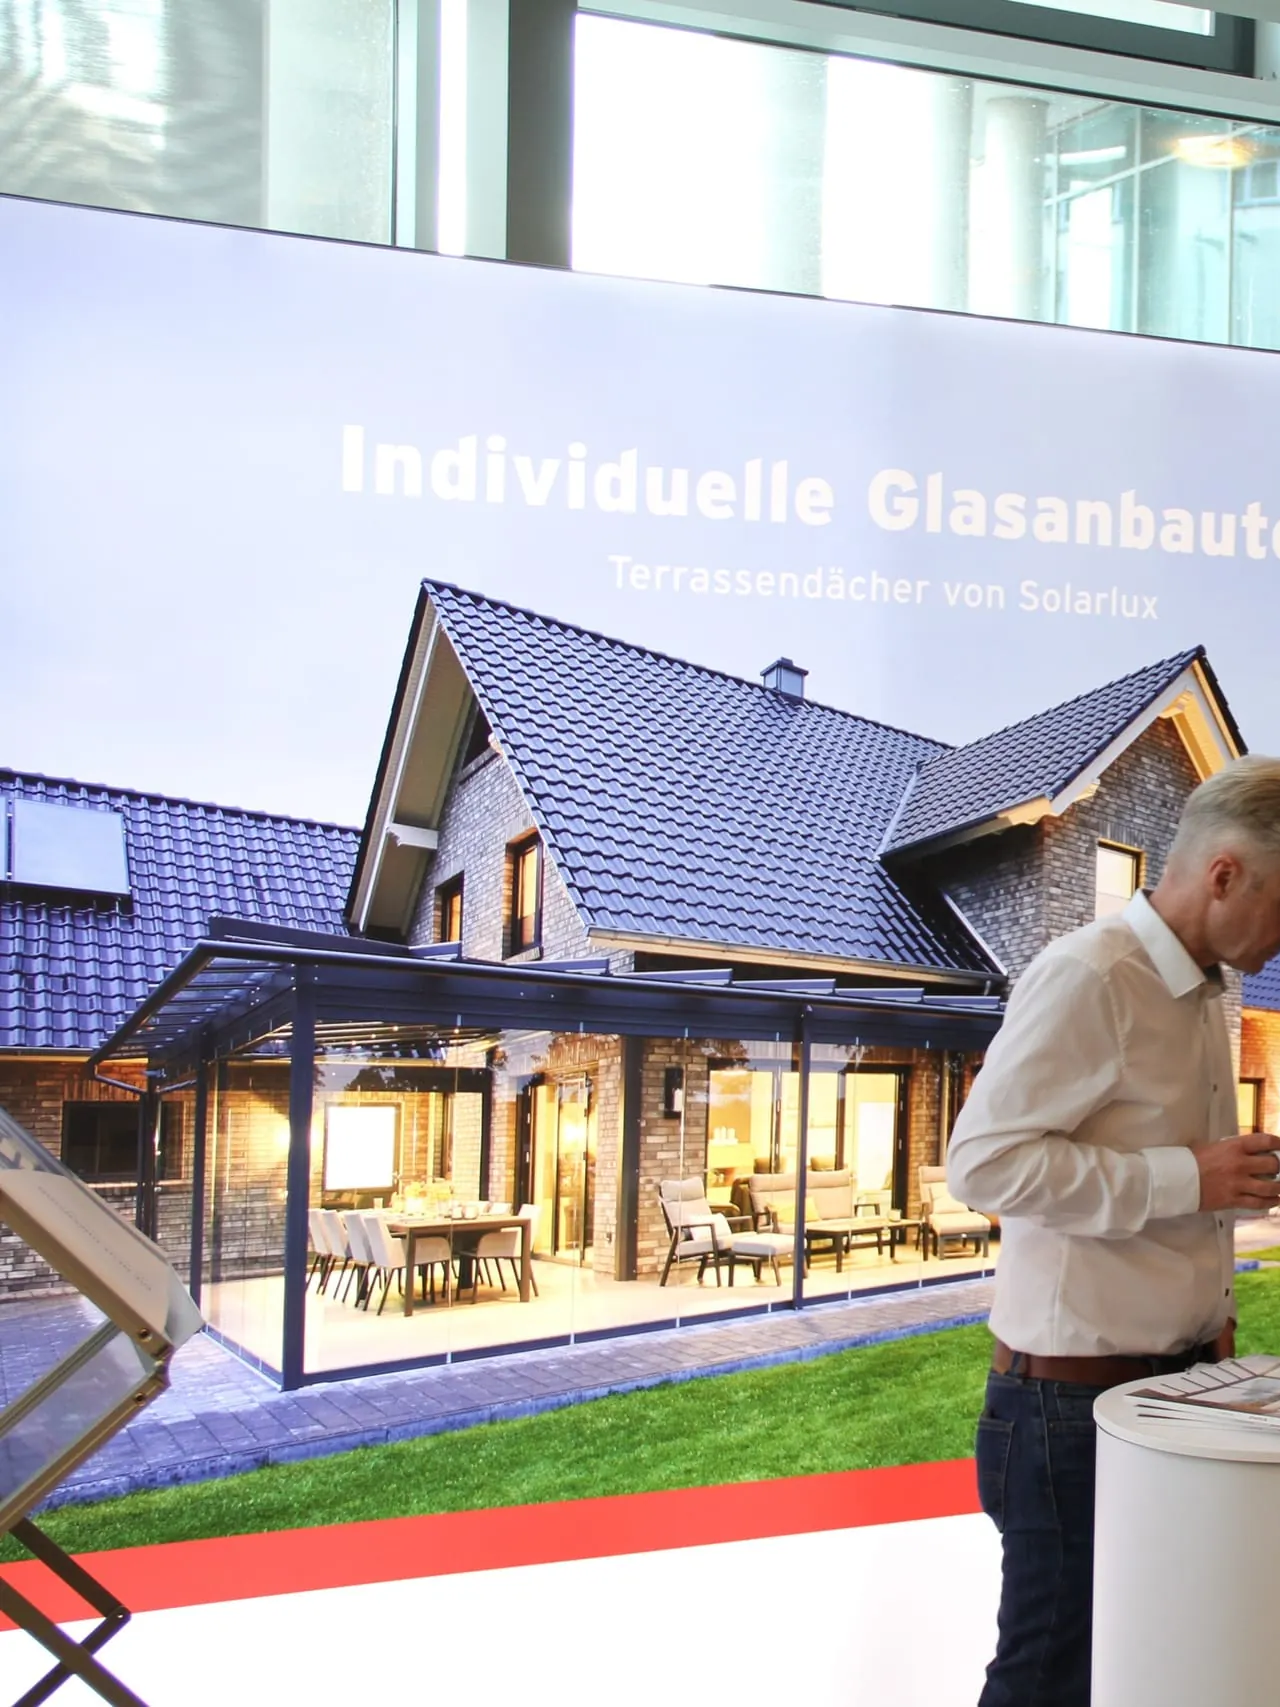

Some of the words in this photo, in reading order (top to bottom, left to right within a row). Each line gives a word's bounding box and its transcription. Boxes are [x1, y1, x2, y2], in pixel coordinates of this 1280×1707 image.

[341, 424, 836, 526] Individuelle
[607, 554, 930, 606] Terrassendächer
[942, 580, 1005, 611] von
[1018, 580, 1160, 621] Solarlux
